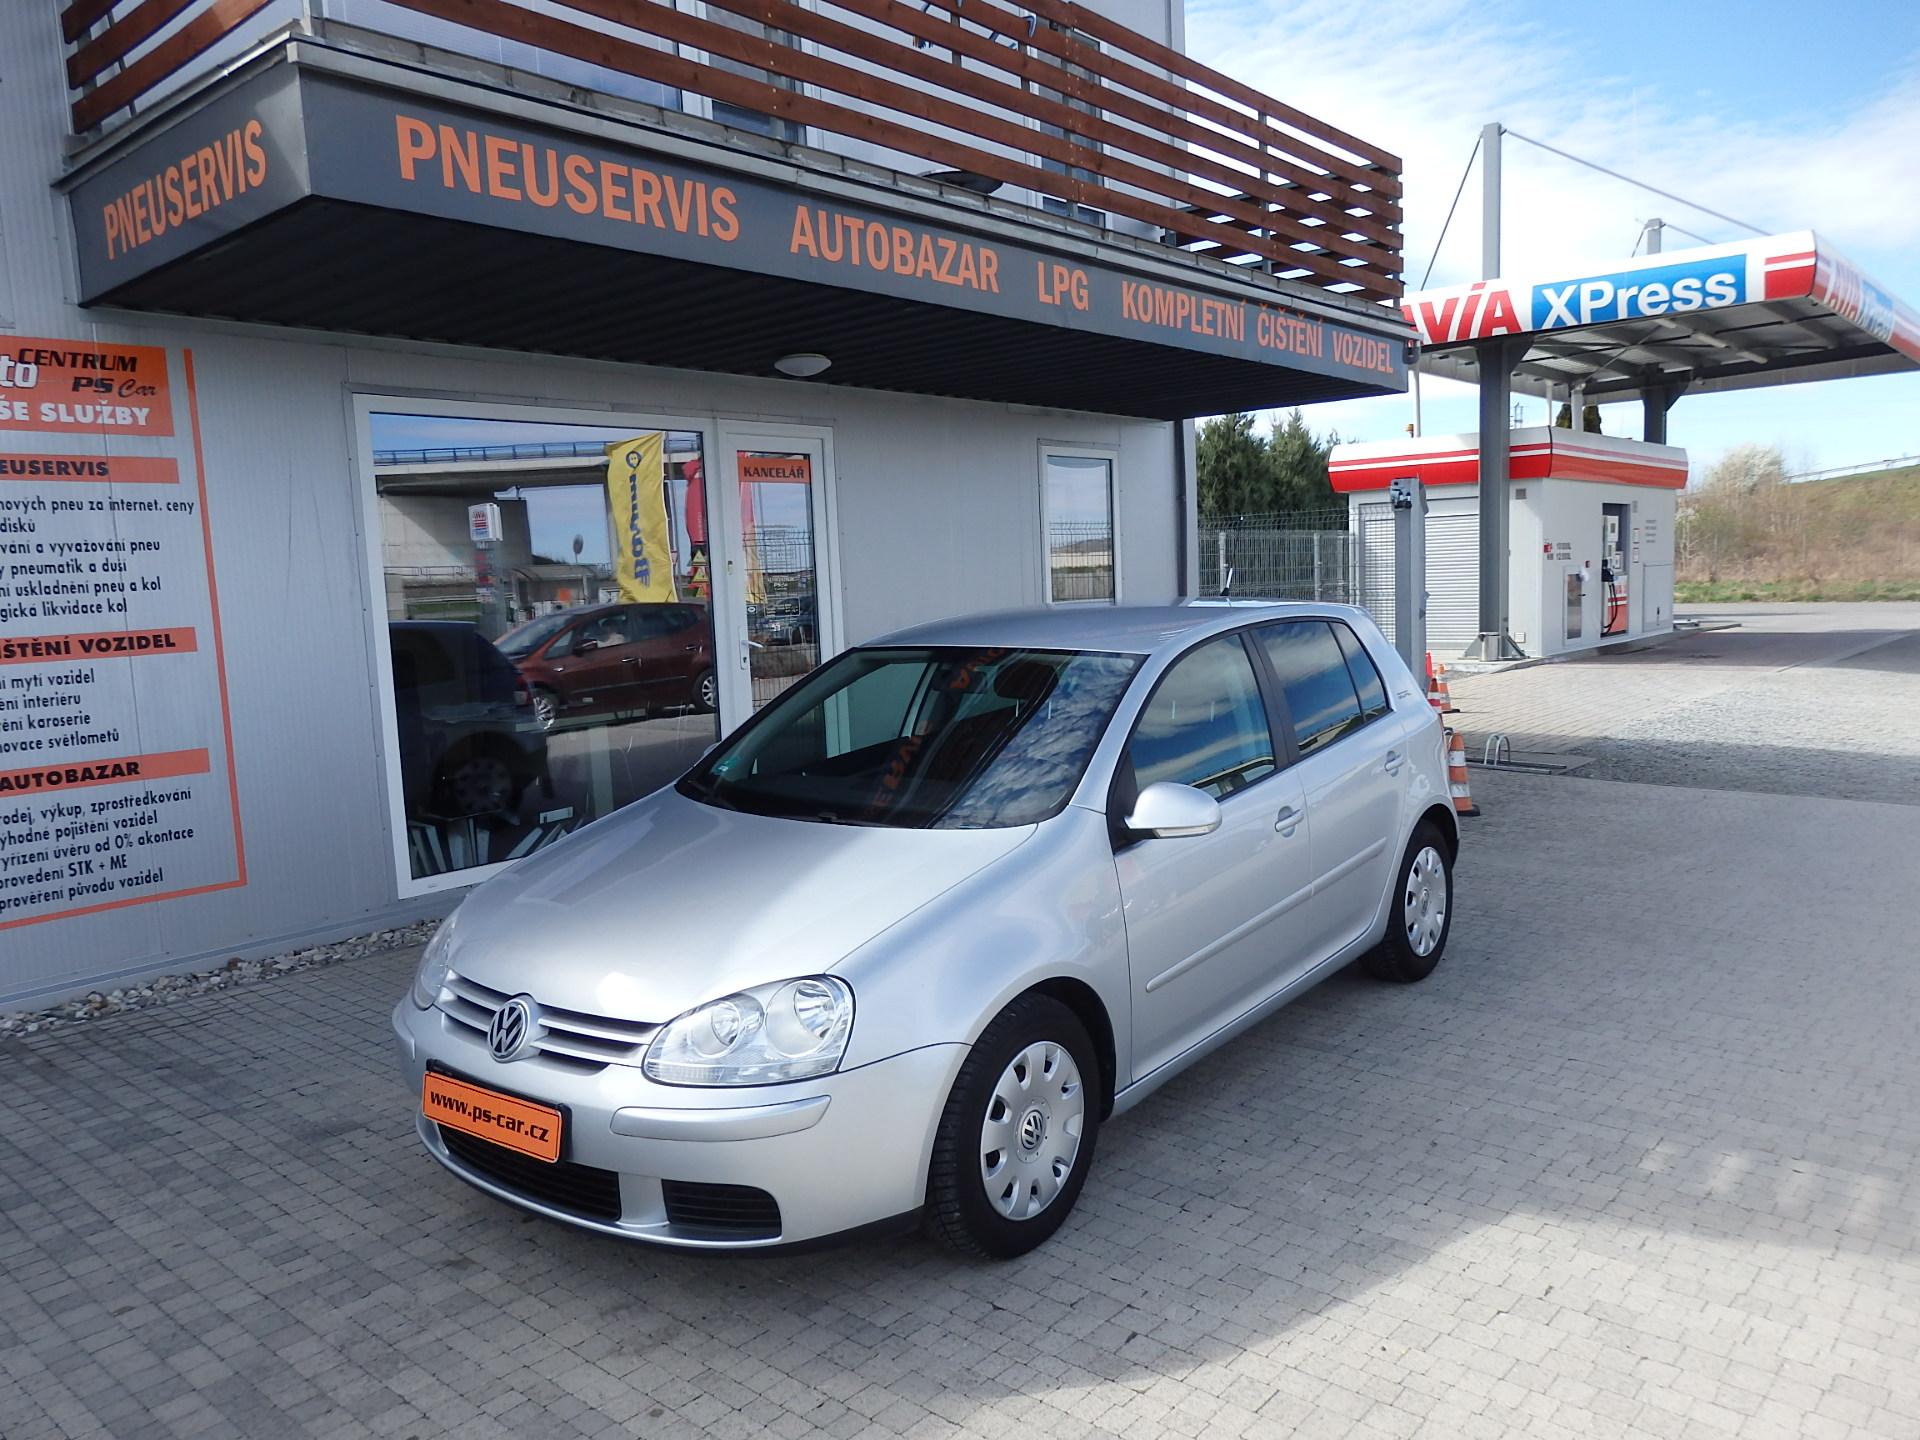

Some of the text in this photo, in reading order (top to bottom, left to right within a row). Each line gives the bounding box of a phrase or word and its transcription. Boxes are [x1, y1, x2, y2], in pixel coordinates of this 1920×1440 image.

[103, 118, 267, 261] PNEUSERVIS
[395, 113, 1394, 374] PNEUSERVIS AUTOBAZAR LPG KOMPLETNÍ ČIŠTĚNÍ VOZIDEL
[1541, 273, 1737, 330] XPress
[19, 348, 138, 373] CENTRUM
[72, 376, 157, 398] PS Car
[40, 398, 150, 426] SLUŽBY
[0, 459, 109, 476] EUSERVIS
[743, 465, 805, 479] KANCELÁŘ
[51, 500, 84, 514] pneu
[88, 500, 104, 511] za
[109, 496, 163, 511] internet.
[166, 501, 194, 515] ceny
[35, 543, 44, 553] a
[130, 541, 160, 555] pneu
[11, 558, 84, 579] pneumatik
[89, 563, 97, 573] a
[15, 580, 90, 597] uskladnění
[94, 582, 125, 597] pneu
[130, 582, 137, 592] a
[141, 576, 161, 591] kol
[42, 600, 103, 616] likvidace
[107, 598, 127, 613] kol
[0, 633, 176, 659] ŠTĚNÍ VOZIDEL
[48, 668, 95, 685] vozidel
[22, 691, 81, 709] interiéru
[27, 710, 91, 729] karoserie
[48, 728, 120, 748] světlometů
[0, 761, 141, 791] AUTOBAZAR
[90, 786, 192, 815] zprostředkování
[113, 809, 158, 829] vozidel
[95, 837, 110, 852] od
[114, 832, 134, 849] 0%
[138, 828, 194, 845] akontace
[68, 859, 94, 877] STK
[110, 854, 128, 870] ME
[69, 877, 115, 901] původu
[119, 867, 164, 888] vozidel
[430, 1091, 549, 1142] www.ps-car.cz
